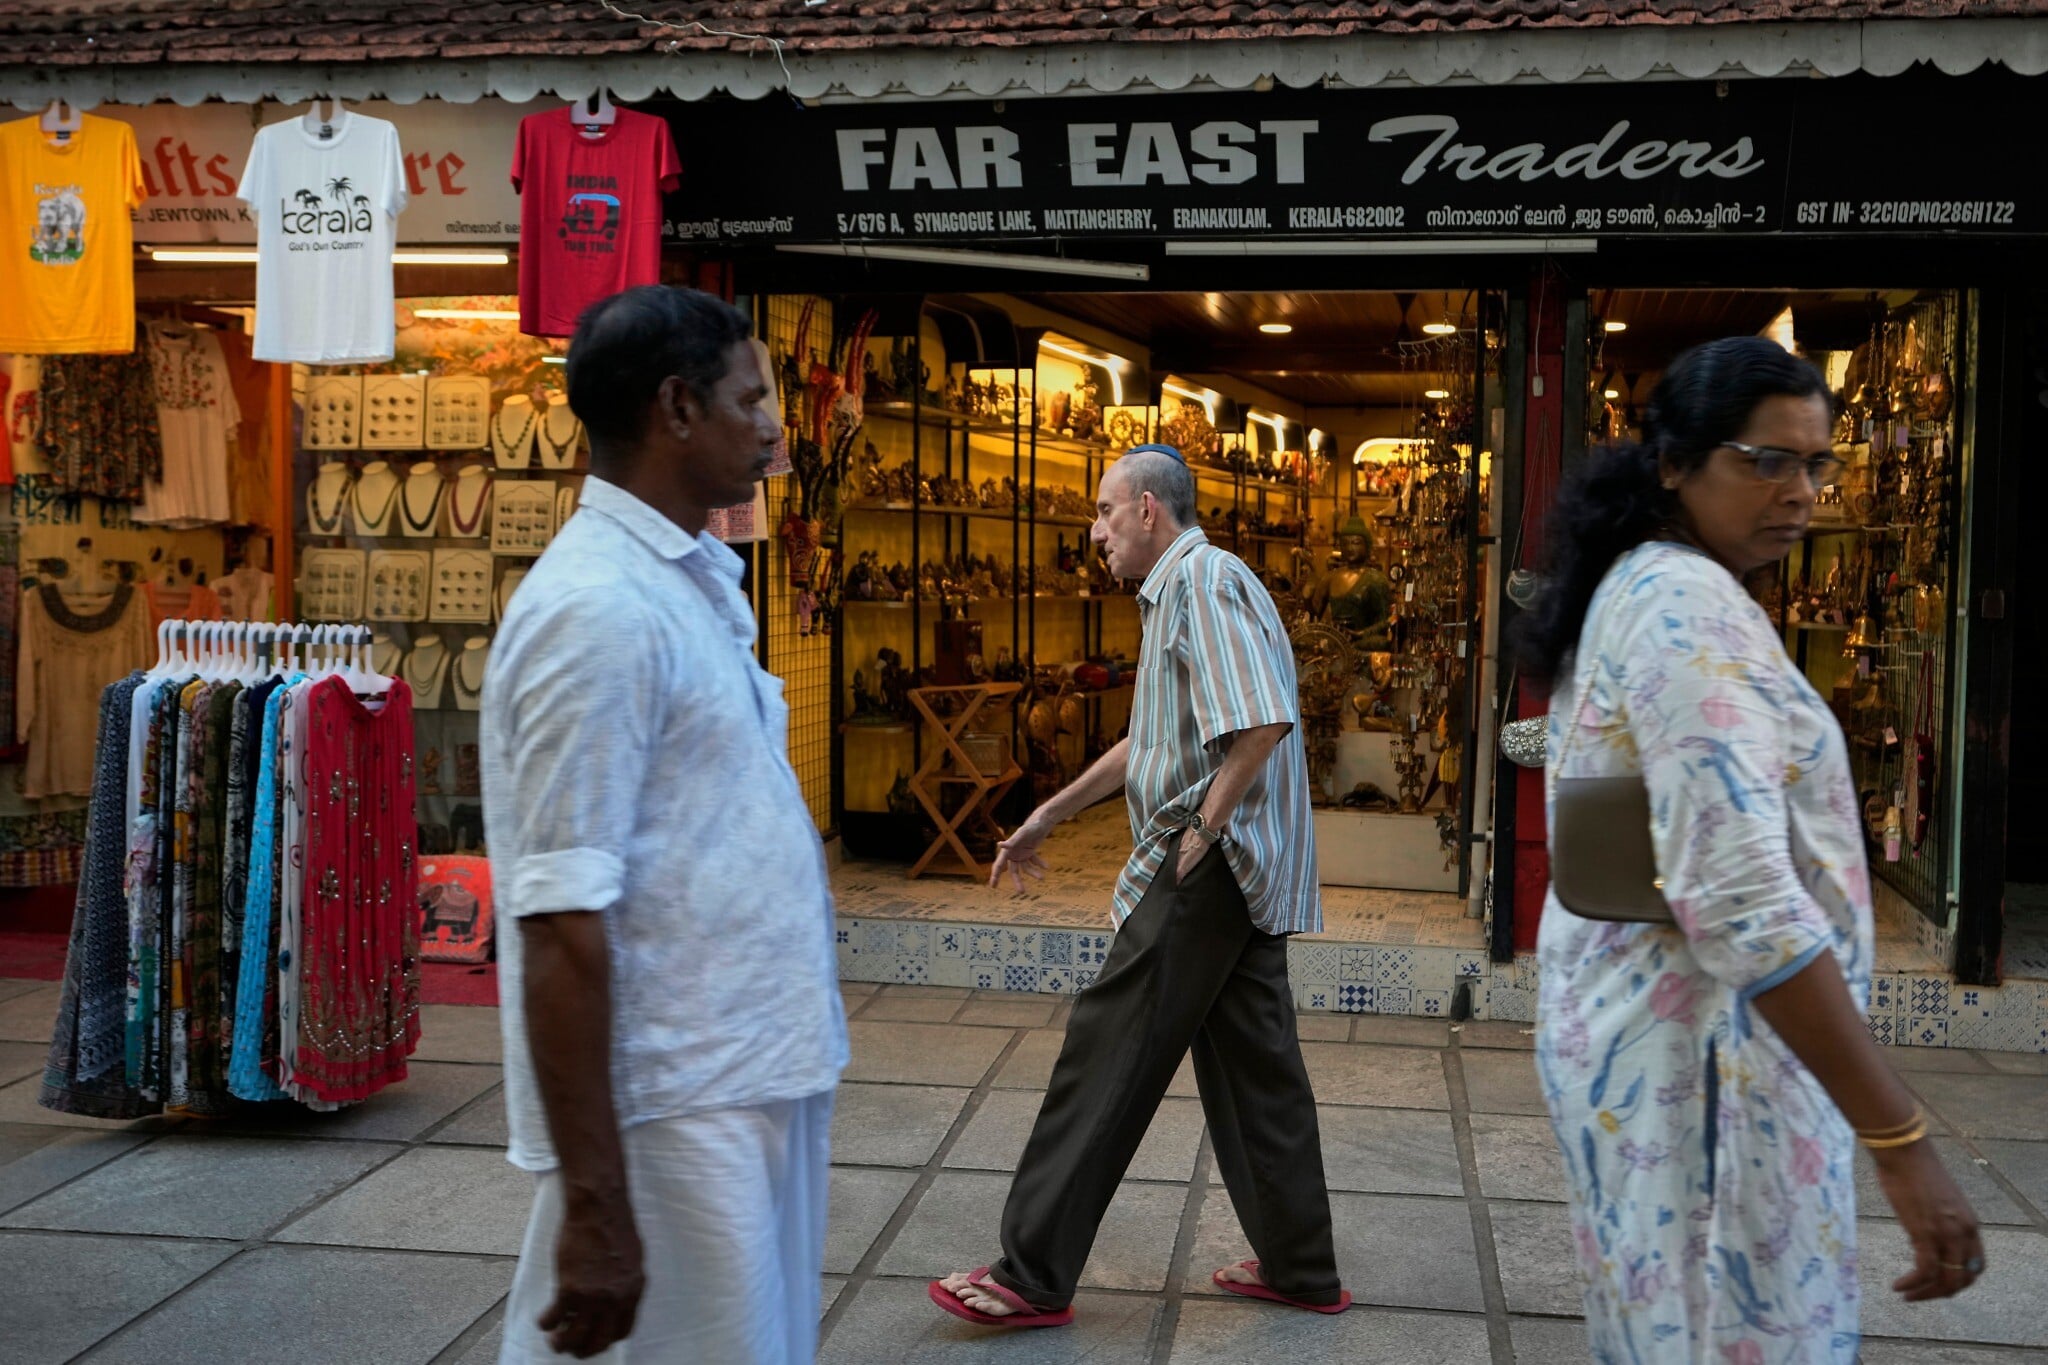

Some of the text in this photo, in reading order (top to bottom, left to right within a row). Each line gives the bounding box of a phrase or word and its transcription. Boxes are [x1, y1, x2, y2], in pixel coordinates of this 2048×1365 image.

[836, 114, 1765, 192] FAR EAST Traders
[404, 151, 468, 196] re
[567, 175, 618, 190] INDIA
[147, 207, 236, 223] JEWTOWN,
[280, 197, 373, 235] kerala
[836, 206, 1405, 235] 5/676 A, SYNAGOGUE LANE, MATTANCHERRY, ERANAKULAM. KERALA-682002
[1797, 202, 1828, 223] GST
[331, 240, 364, 251] Country
